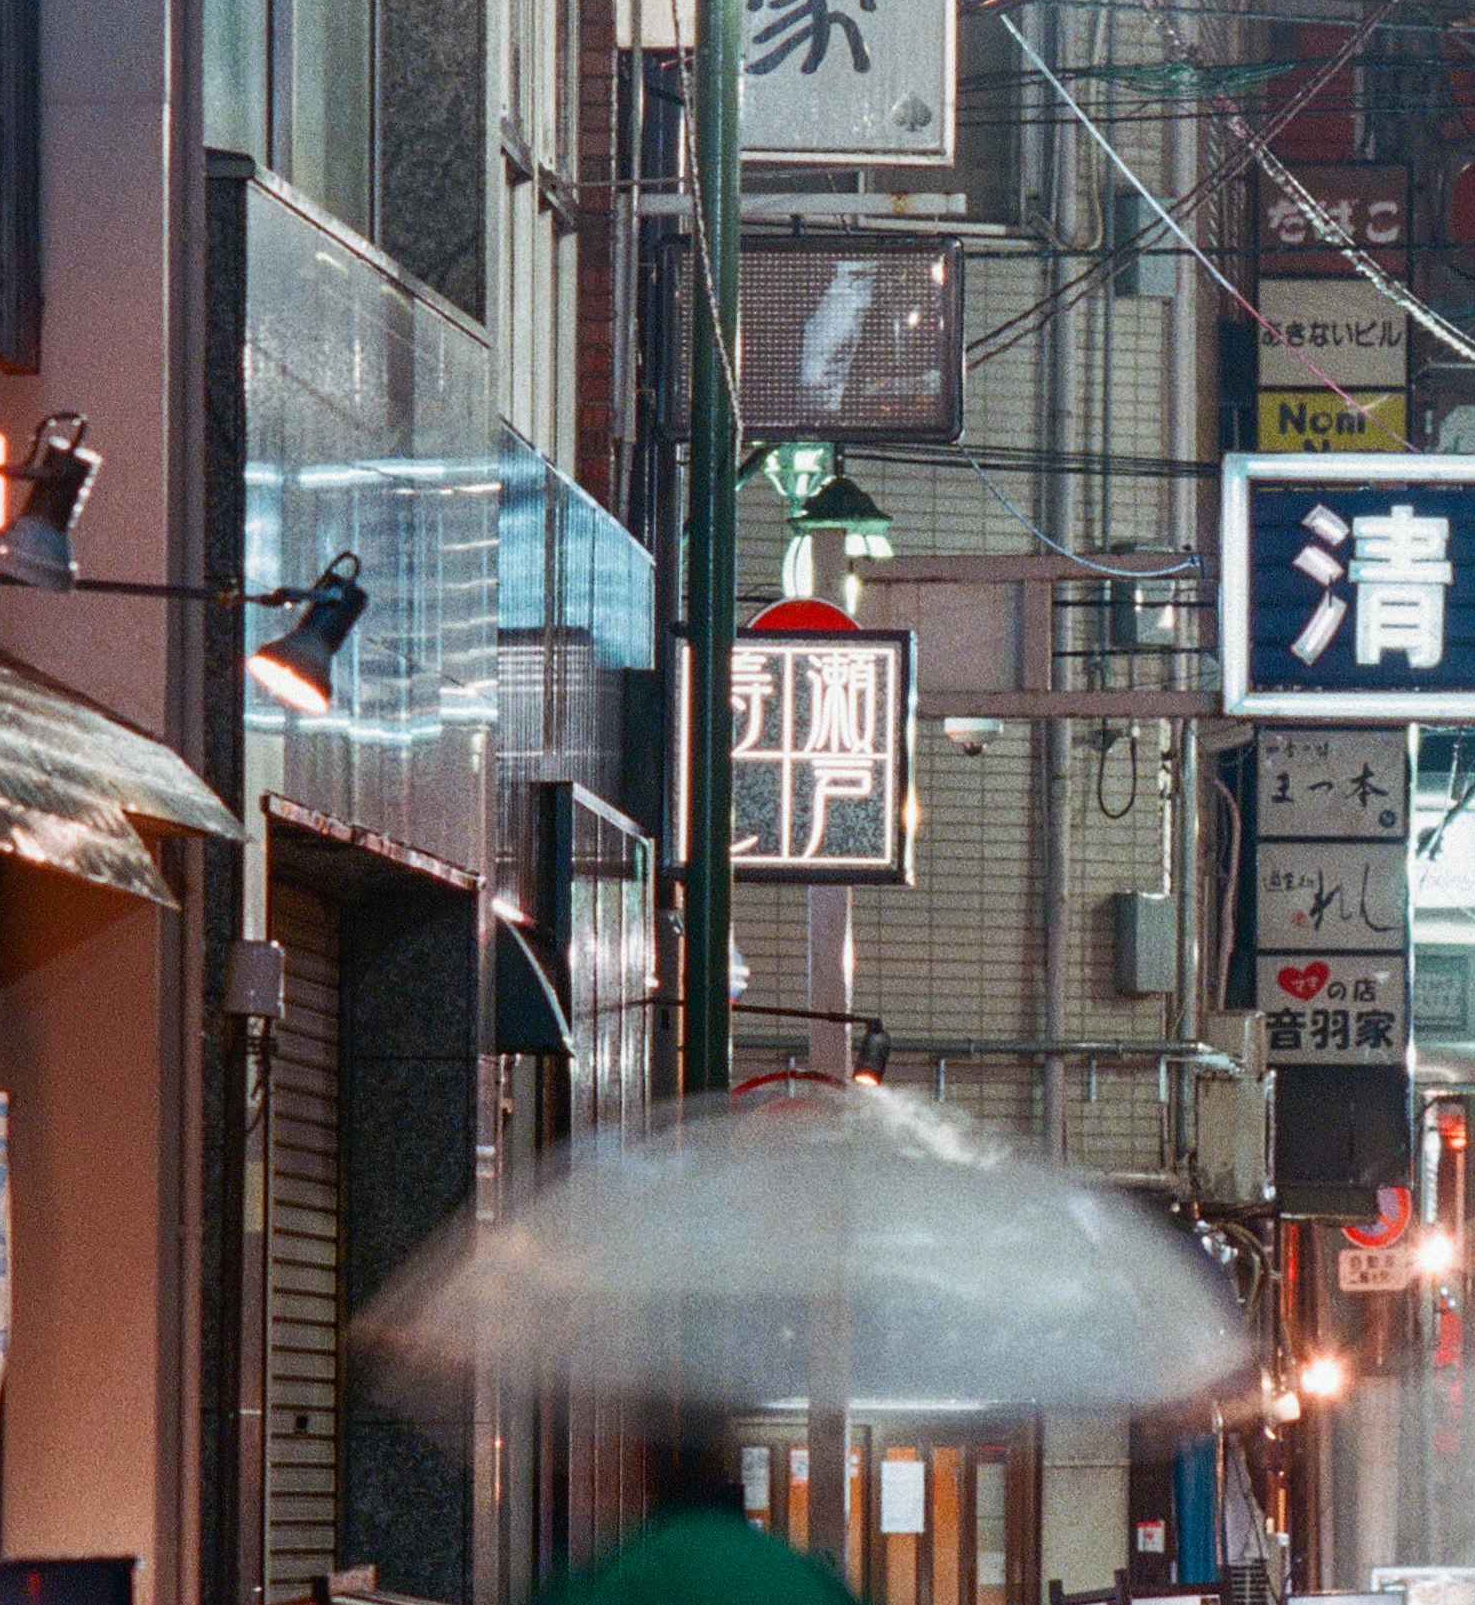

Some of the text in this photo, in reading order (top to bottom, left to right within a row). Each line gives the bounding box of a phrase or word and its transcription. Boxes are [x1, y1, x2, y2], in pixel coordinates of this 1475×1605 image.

[1267, 199, 1401, 244] たばこ
[1261, 320, 1402, 347] あきないビル
[1278, 402, 1366, 435] Nom
[807, 653, 876, 858] 瀬戸
[1265, 1006, 1396, 1050] 音羽家
